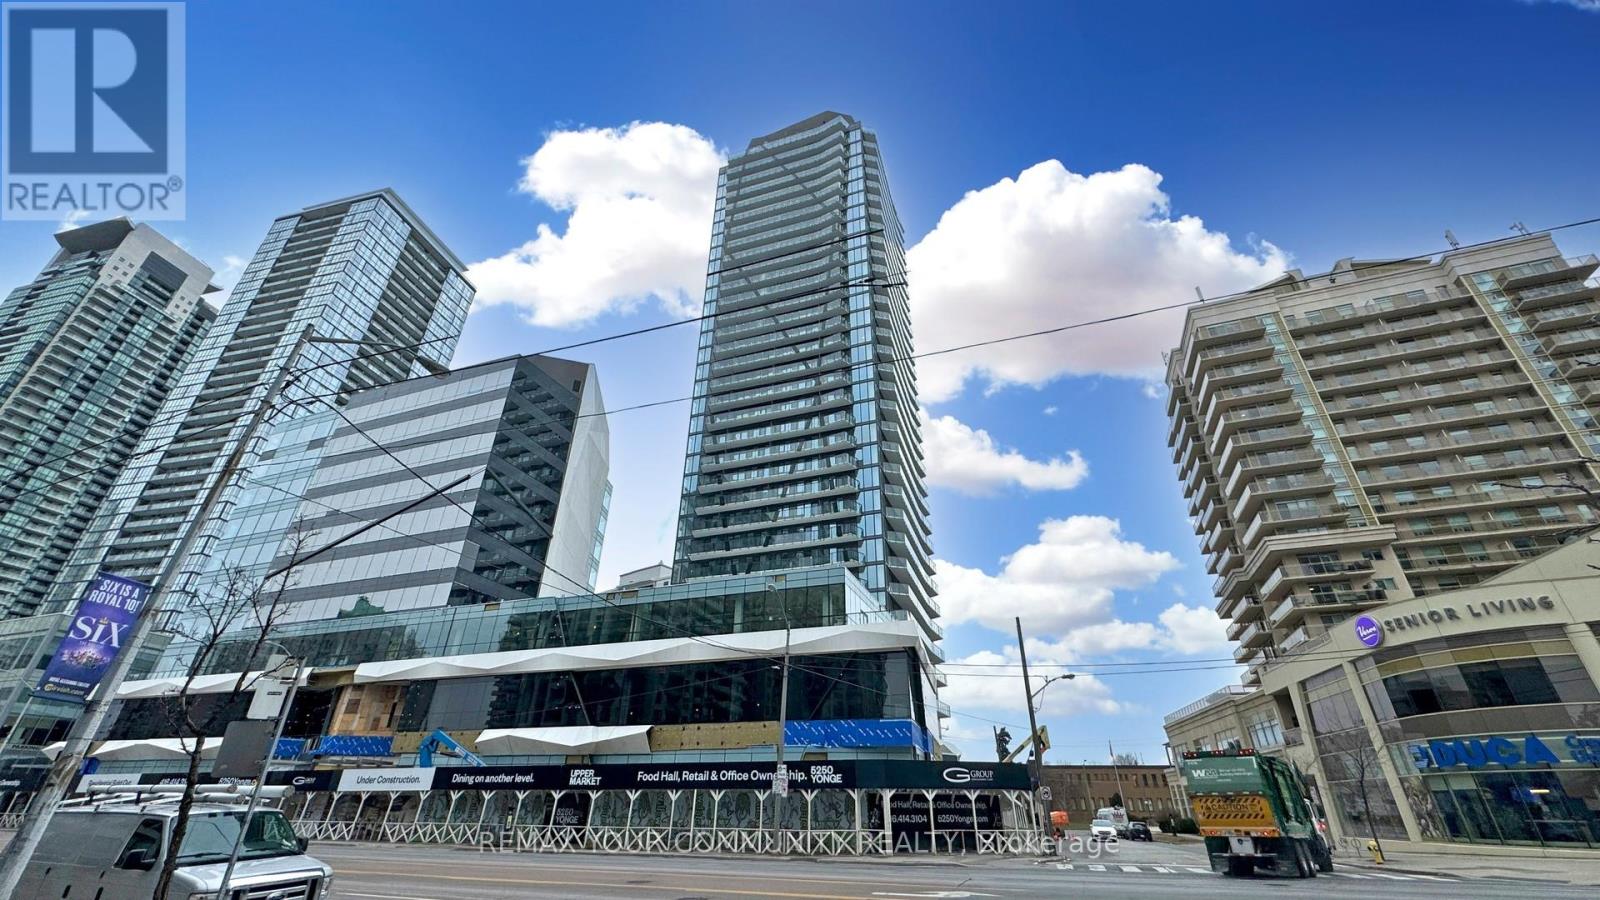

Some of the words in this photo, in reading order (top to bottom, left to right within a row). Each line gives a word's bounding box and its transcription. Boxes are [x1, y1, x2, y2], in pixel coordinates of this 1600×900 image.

[100, 579, 121, 594] SIX
[119, 584, 132, 597] IS
[131, 587, 140, 599] A
[88, 589, 123, 608] ROYAL
[1383, 607, 1461, 633] SENIOR
[1466, 595, 1555, 618] LIVING
[1429, 735, 1562, 769] DUCA
[570, 769, 595, 777] UPPER
[810, 765, 834, 775] 5250
[970, 770, 994, 778] GROUP
[356, 775, 376, 785] Under
[377, 775, 421, 784] Construction.
[452, 773, 475, 785] Dining
[485, 774, 514, 783] another
[515, 773, 535, 782] level.
[637, 771, 660, 781] Food
[660, 771, 681, 783] Hall,
[682, 770, 709, 781] Retail
[710, 771, 718, 781] &
[720, 770, 749, 781] Office
[750, 769, 808, 783] Ownehip.
[811, 774, 843, 784] YONGE
[569, 777, 602, 786] MARKET
[556, 815, 579, 824] YONGE
